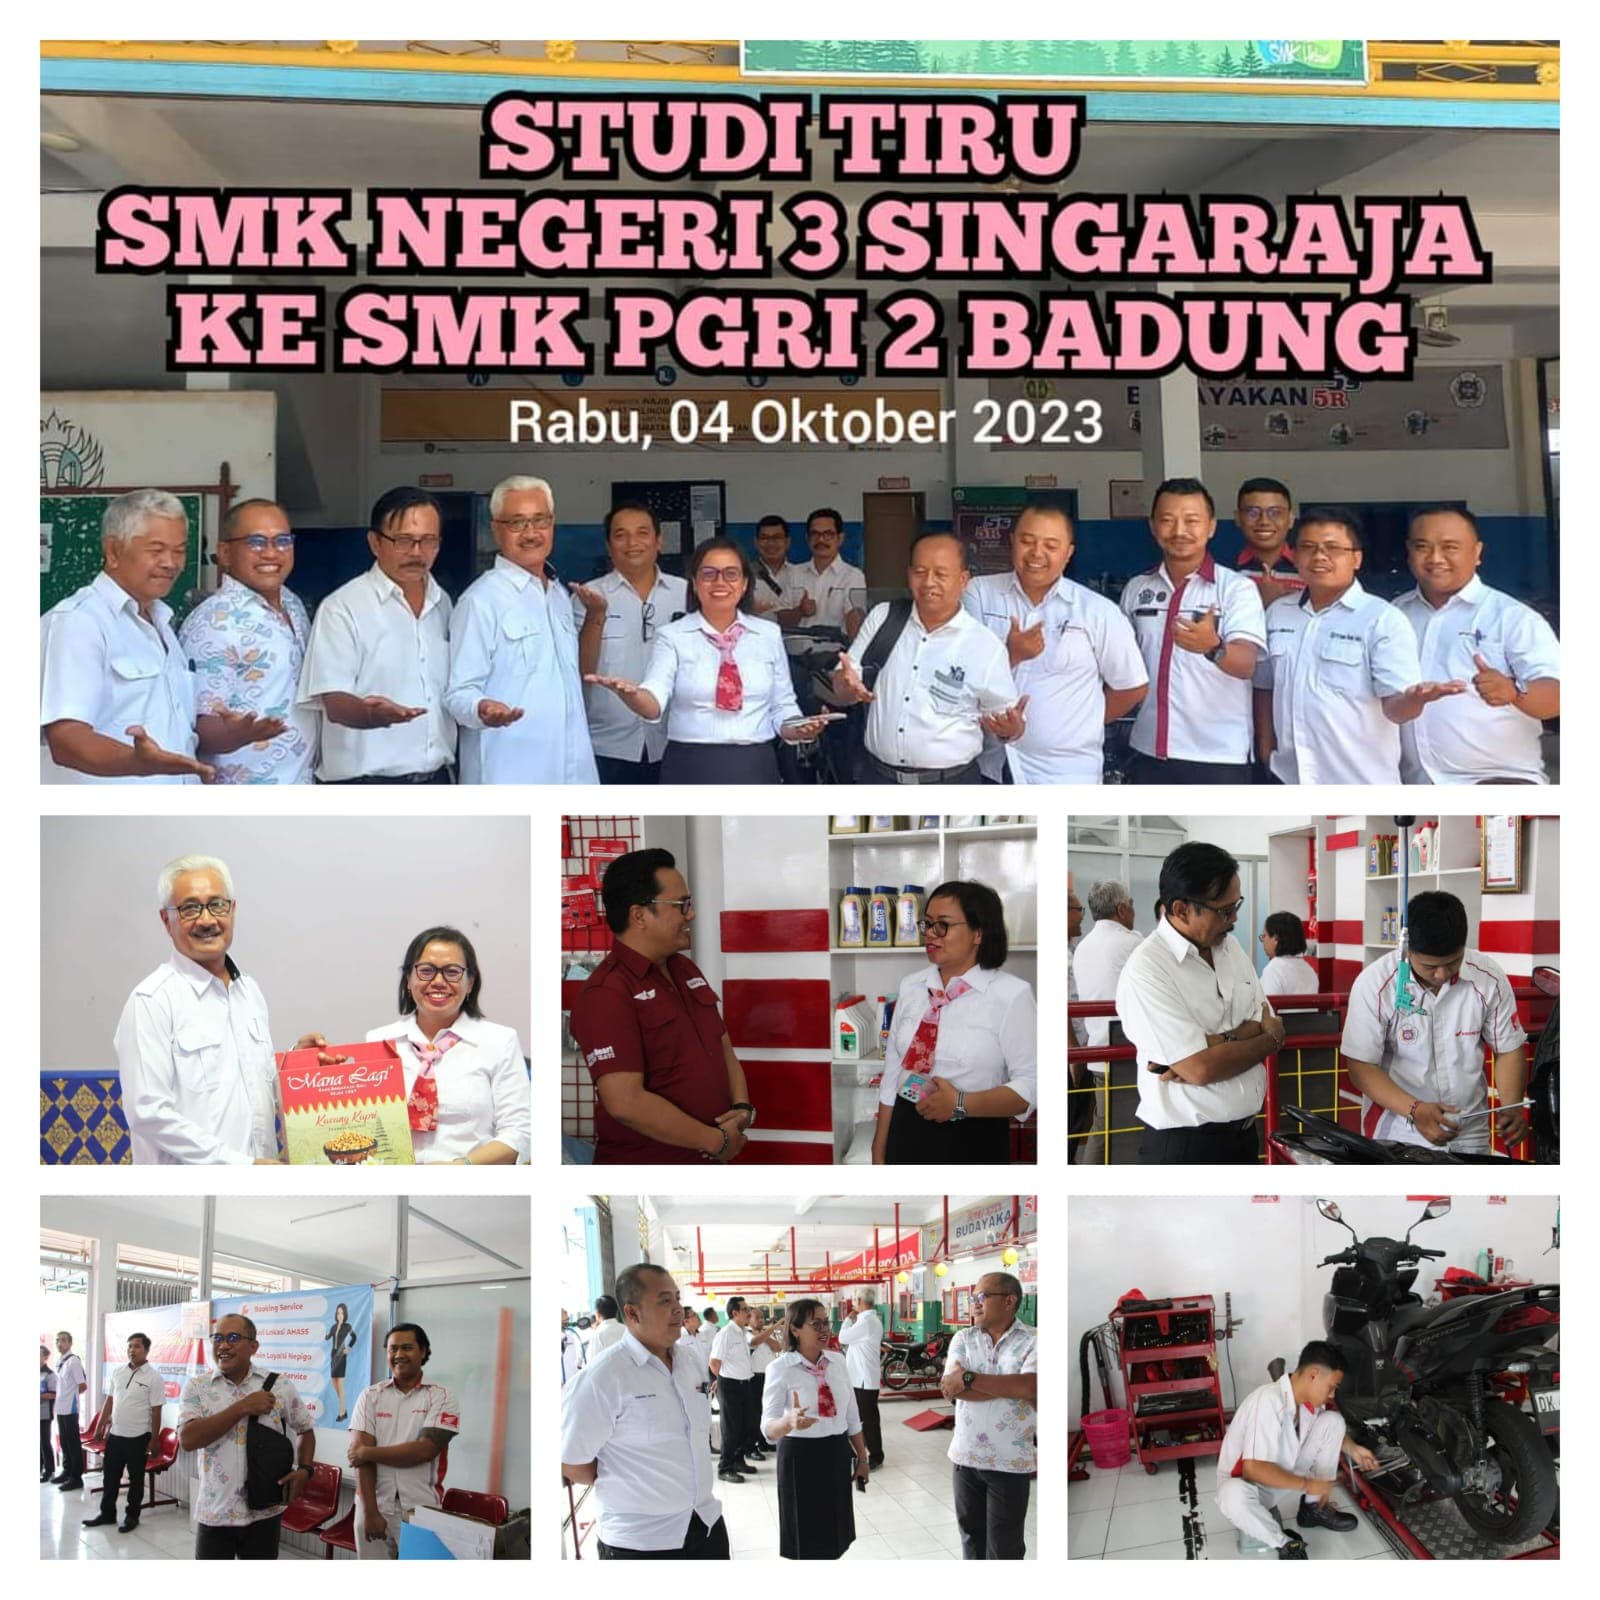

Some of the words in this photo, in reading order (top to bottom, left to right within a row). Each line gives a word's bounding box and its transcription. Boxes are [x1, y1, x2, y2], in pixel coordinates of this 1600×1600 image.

[1127, 386, 1307, 406] BYAKAN
[287, 1071, 345, 1091] Mana
[347, 1065, 389, 1088] Lagi
[315, 1114, 349, 1127] Kacang
[351, 1110, 377, 1123] Kapri
[955, 1209, 1012, 1239] BUDAYAKA
[254, 1305, 278, 1313] Booking
[279, 1303, 304, 1311] Service
[1538, 1396, 1556, 1412] DK
